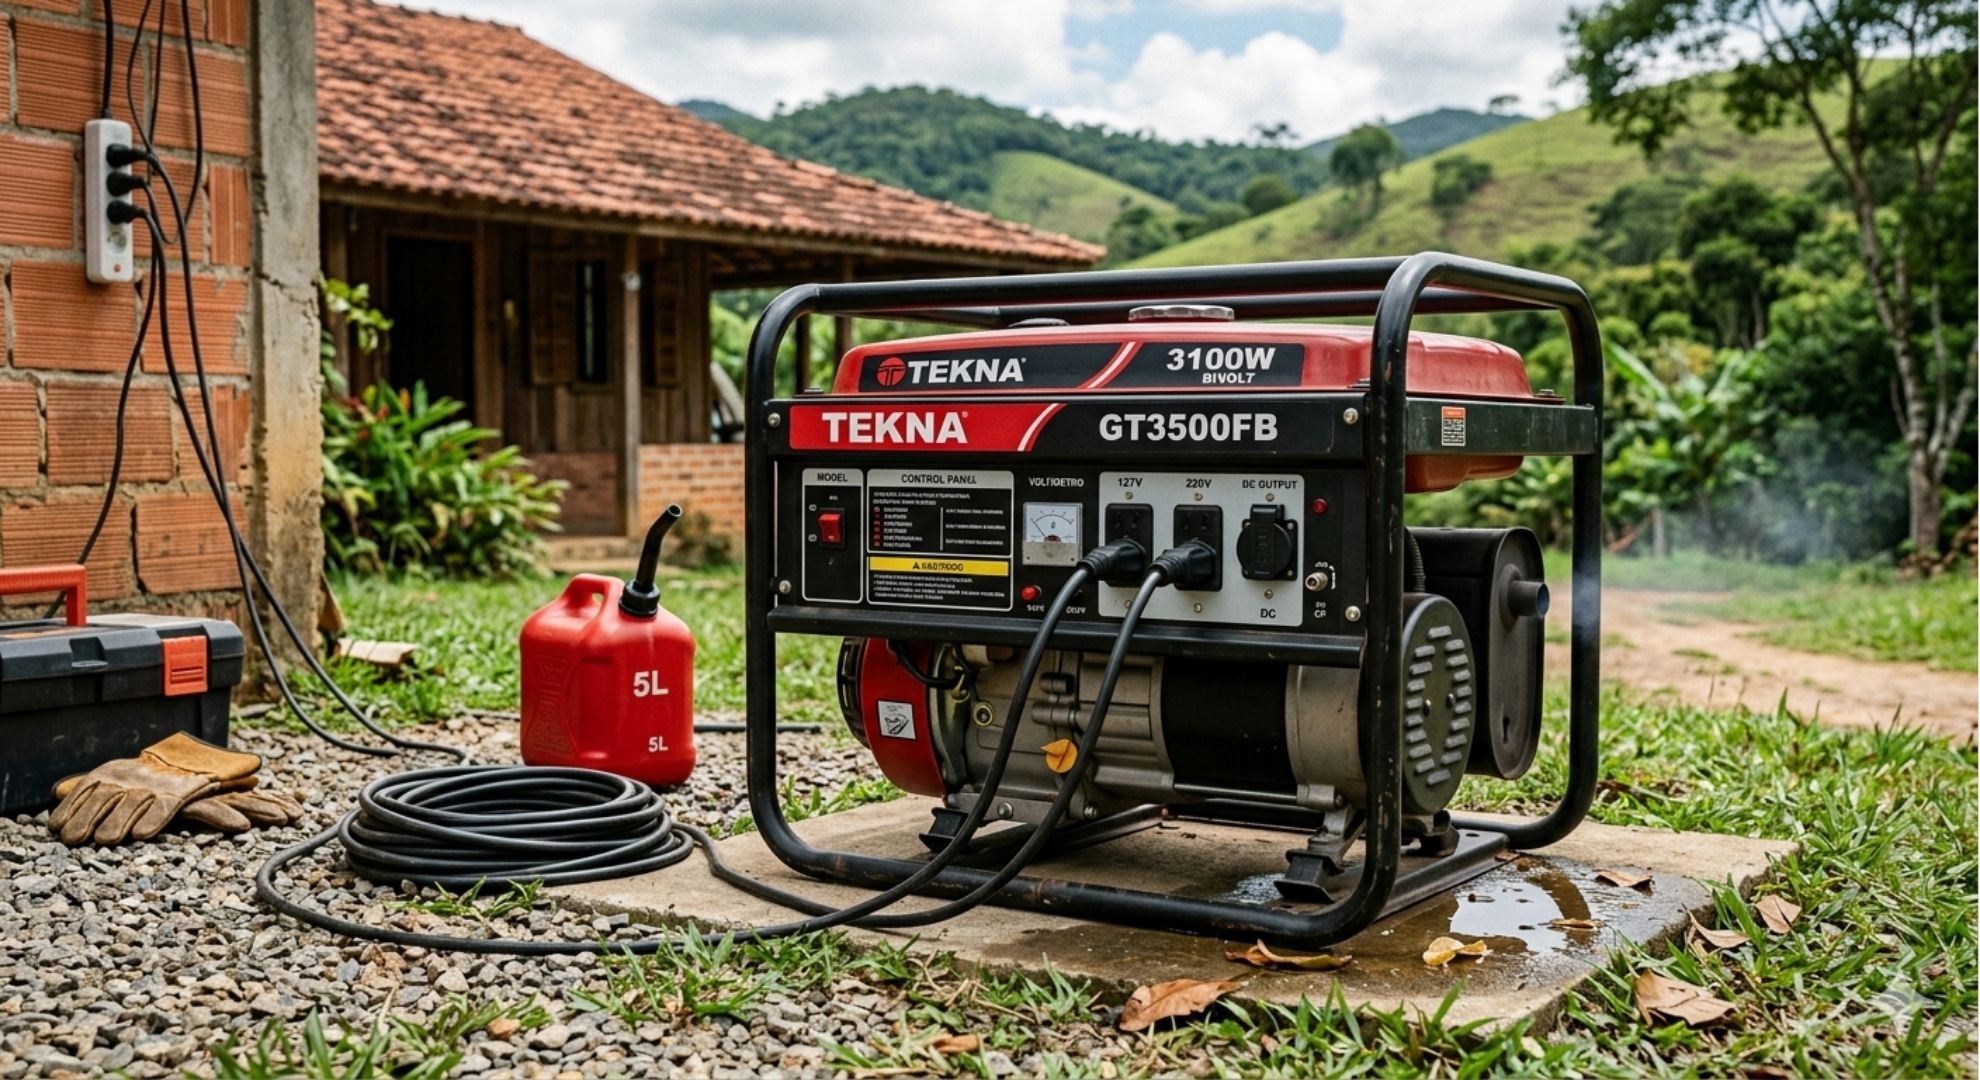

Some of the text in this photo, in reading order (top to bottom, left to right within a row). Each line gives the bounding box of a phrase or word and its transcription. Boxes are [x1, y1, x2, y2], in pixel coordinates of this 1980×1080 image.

[1166, 347, 1277, 371] 3100W
[908, 357, 1025, 384] TEKNA
[1202, 372, 1256, 384] BIVOLT
[821, 411, 969, 444] TEKNA
[1099, 413, 1278, 442] GT3500FB
[901, 473, 945, 484] CONTROL
[1118, 477, 1143, 488] 127V
[1260, 608, 1276, 619] DC
[633, 670, 669, 698] 5L
[648, 736, 669, 752] 5L
